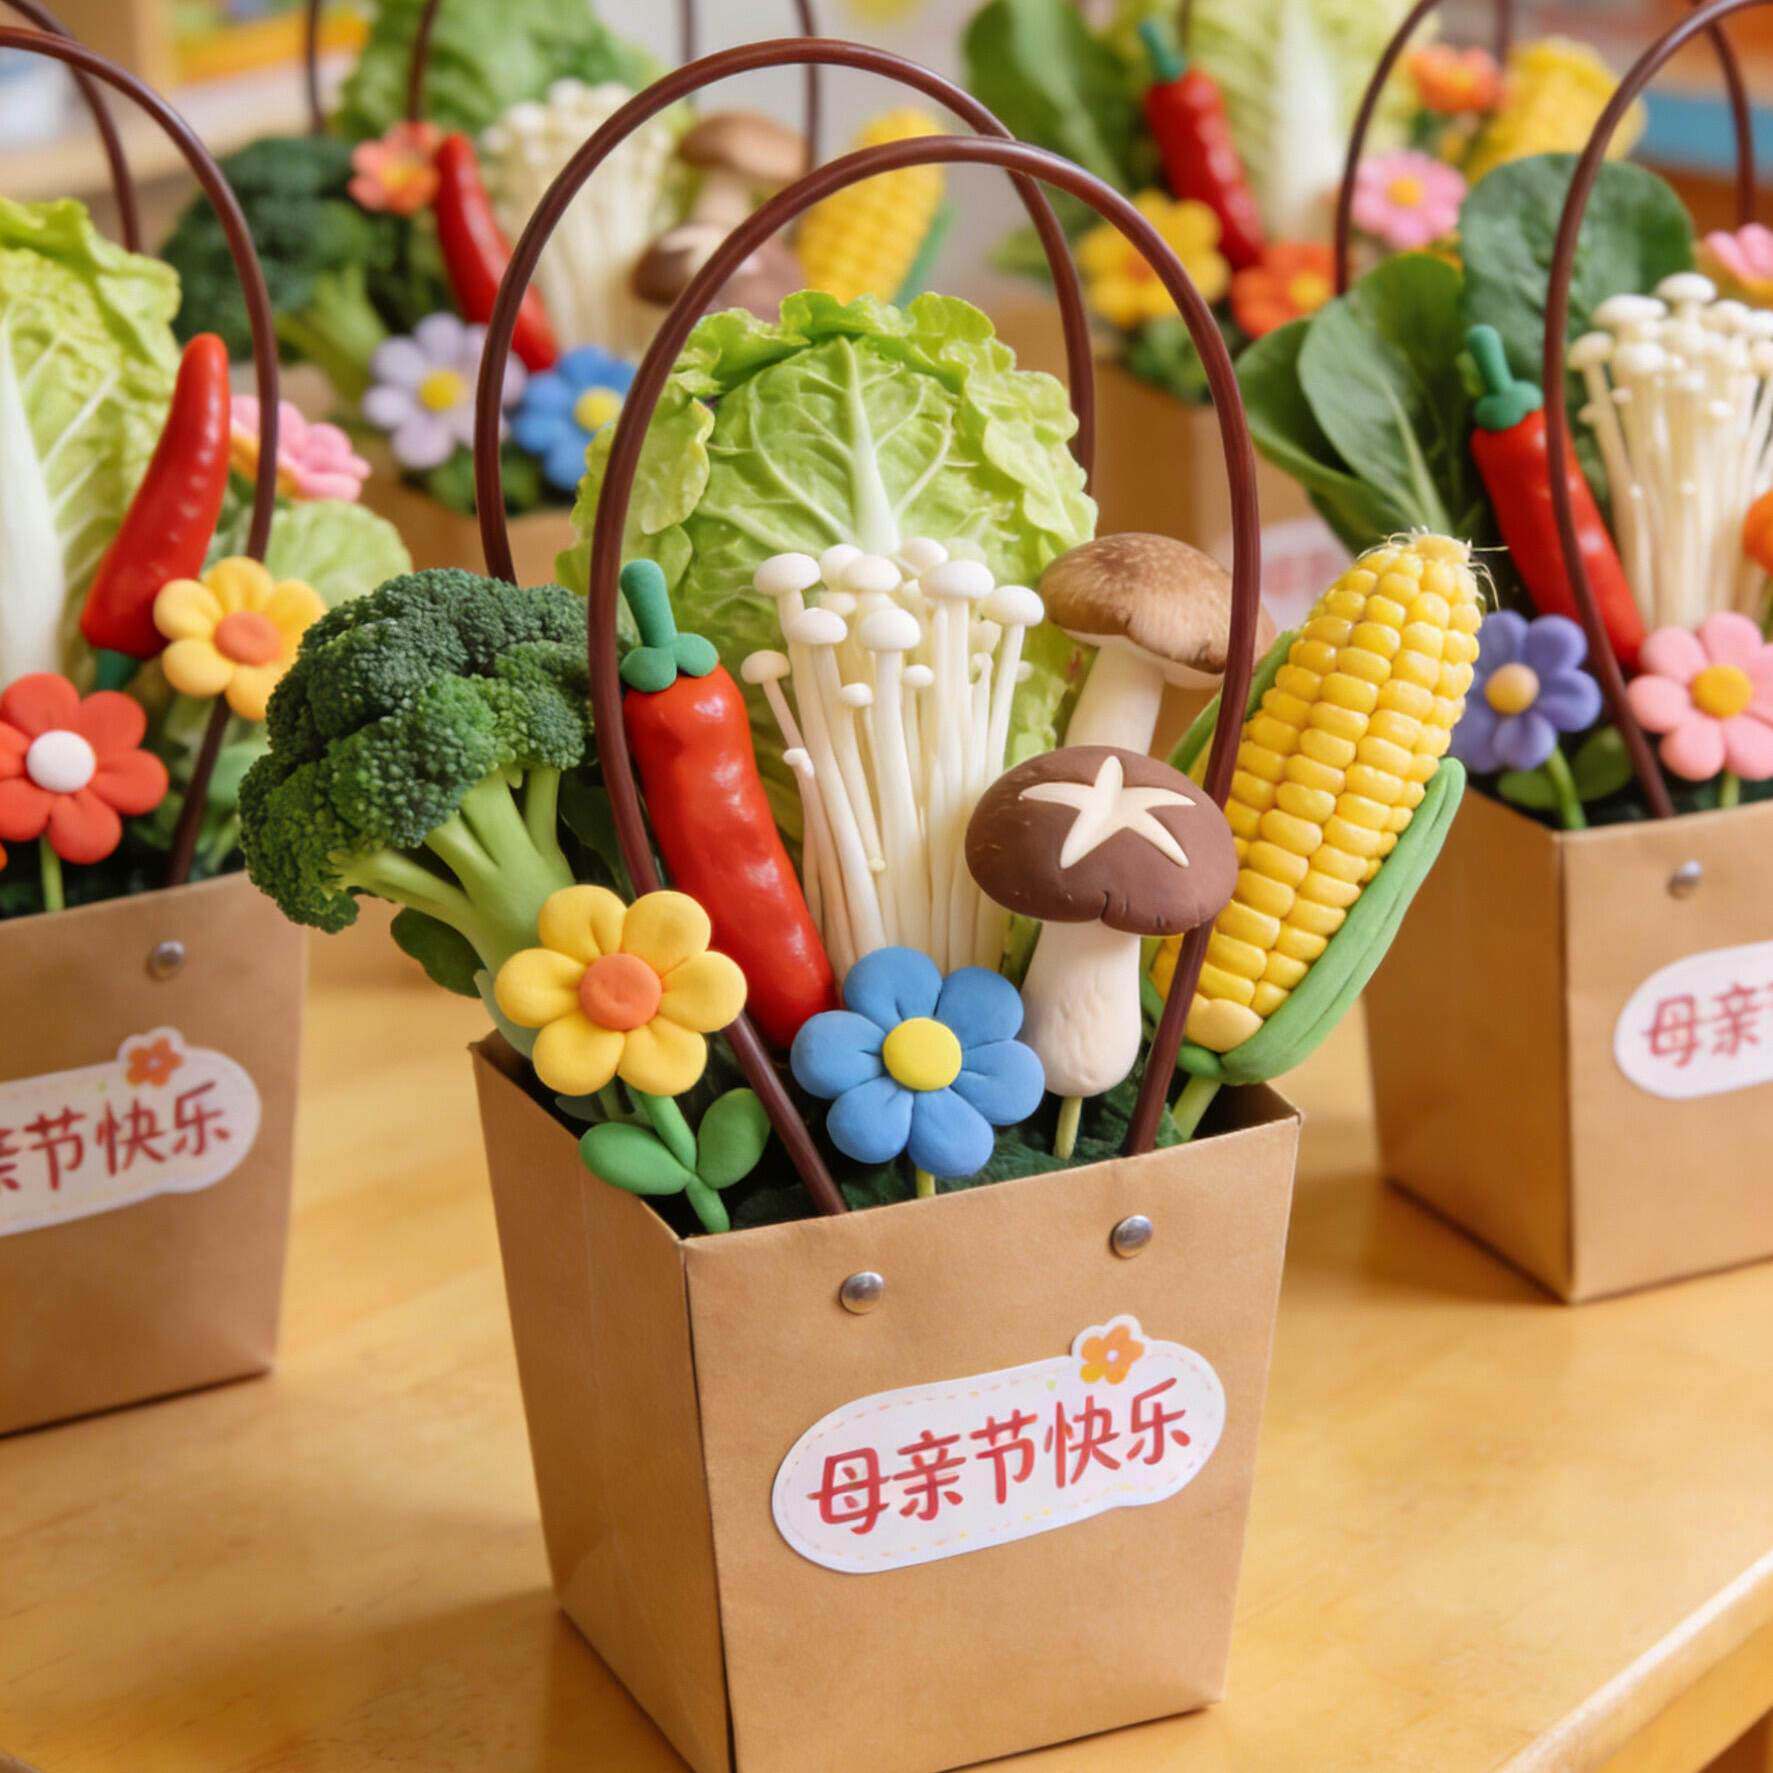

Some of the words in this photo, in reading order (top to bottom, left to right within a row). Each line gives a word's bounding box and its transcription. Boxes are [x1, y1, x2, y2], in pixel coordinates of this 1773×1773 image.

[1640, 981, 1773, 1069] 母亲
[806, 1377, 1191, 1535] 母亲节快乐
